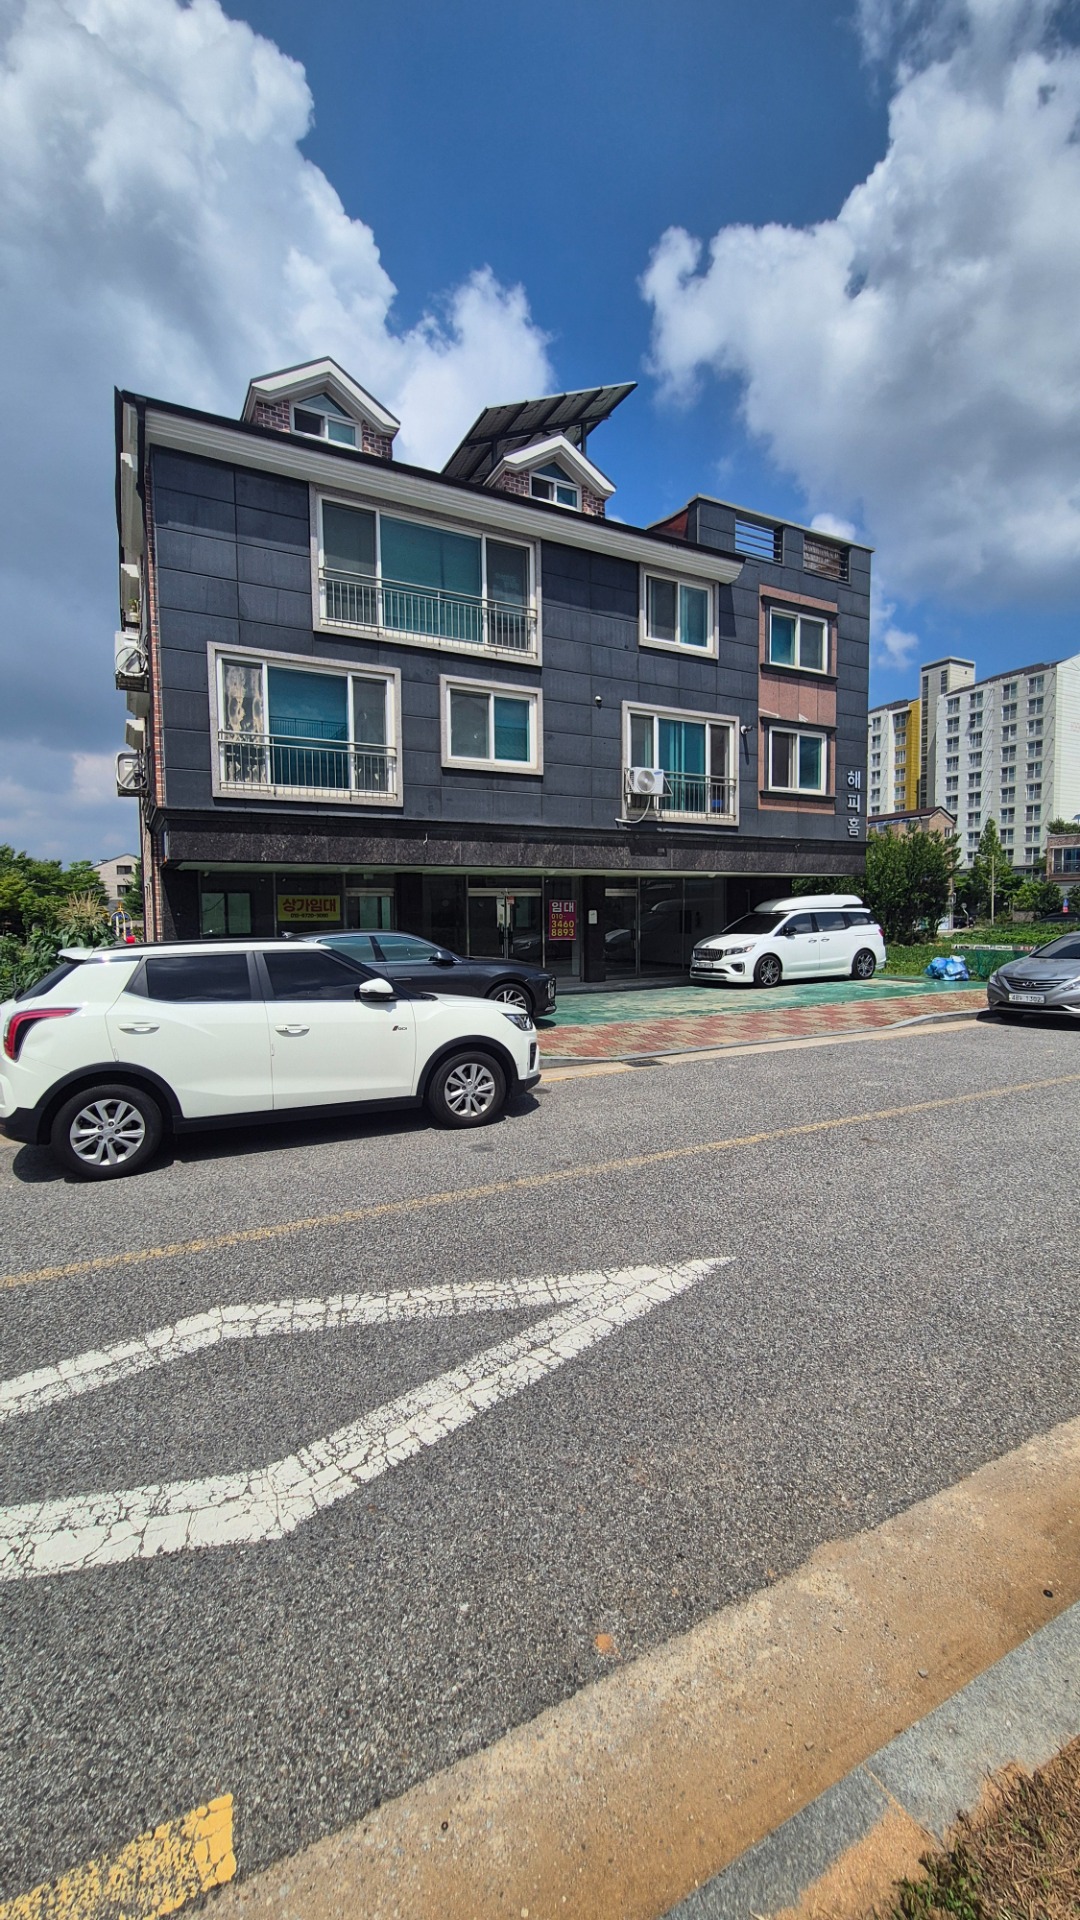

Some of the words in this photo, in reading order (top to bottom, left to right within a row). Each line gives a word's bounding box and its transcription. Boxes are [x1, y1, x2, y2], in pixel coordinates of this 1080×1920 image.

[847, 770, 861, 836] 해피홈
[282, 898, 337, 912] 상가임대
[551, 901, 575, 913] 임대
[551, 920, 575, 928] 3460
[551, 928, 575, 937] 8893
